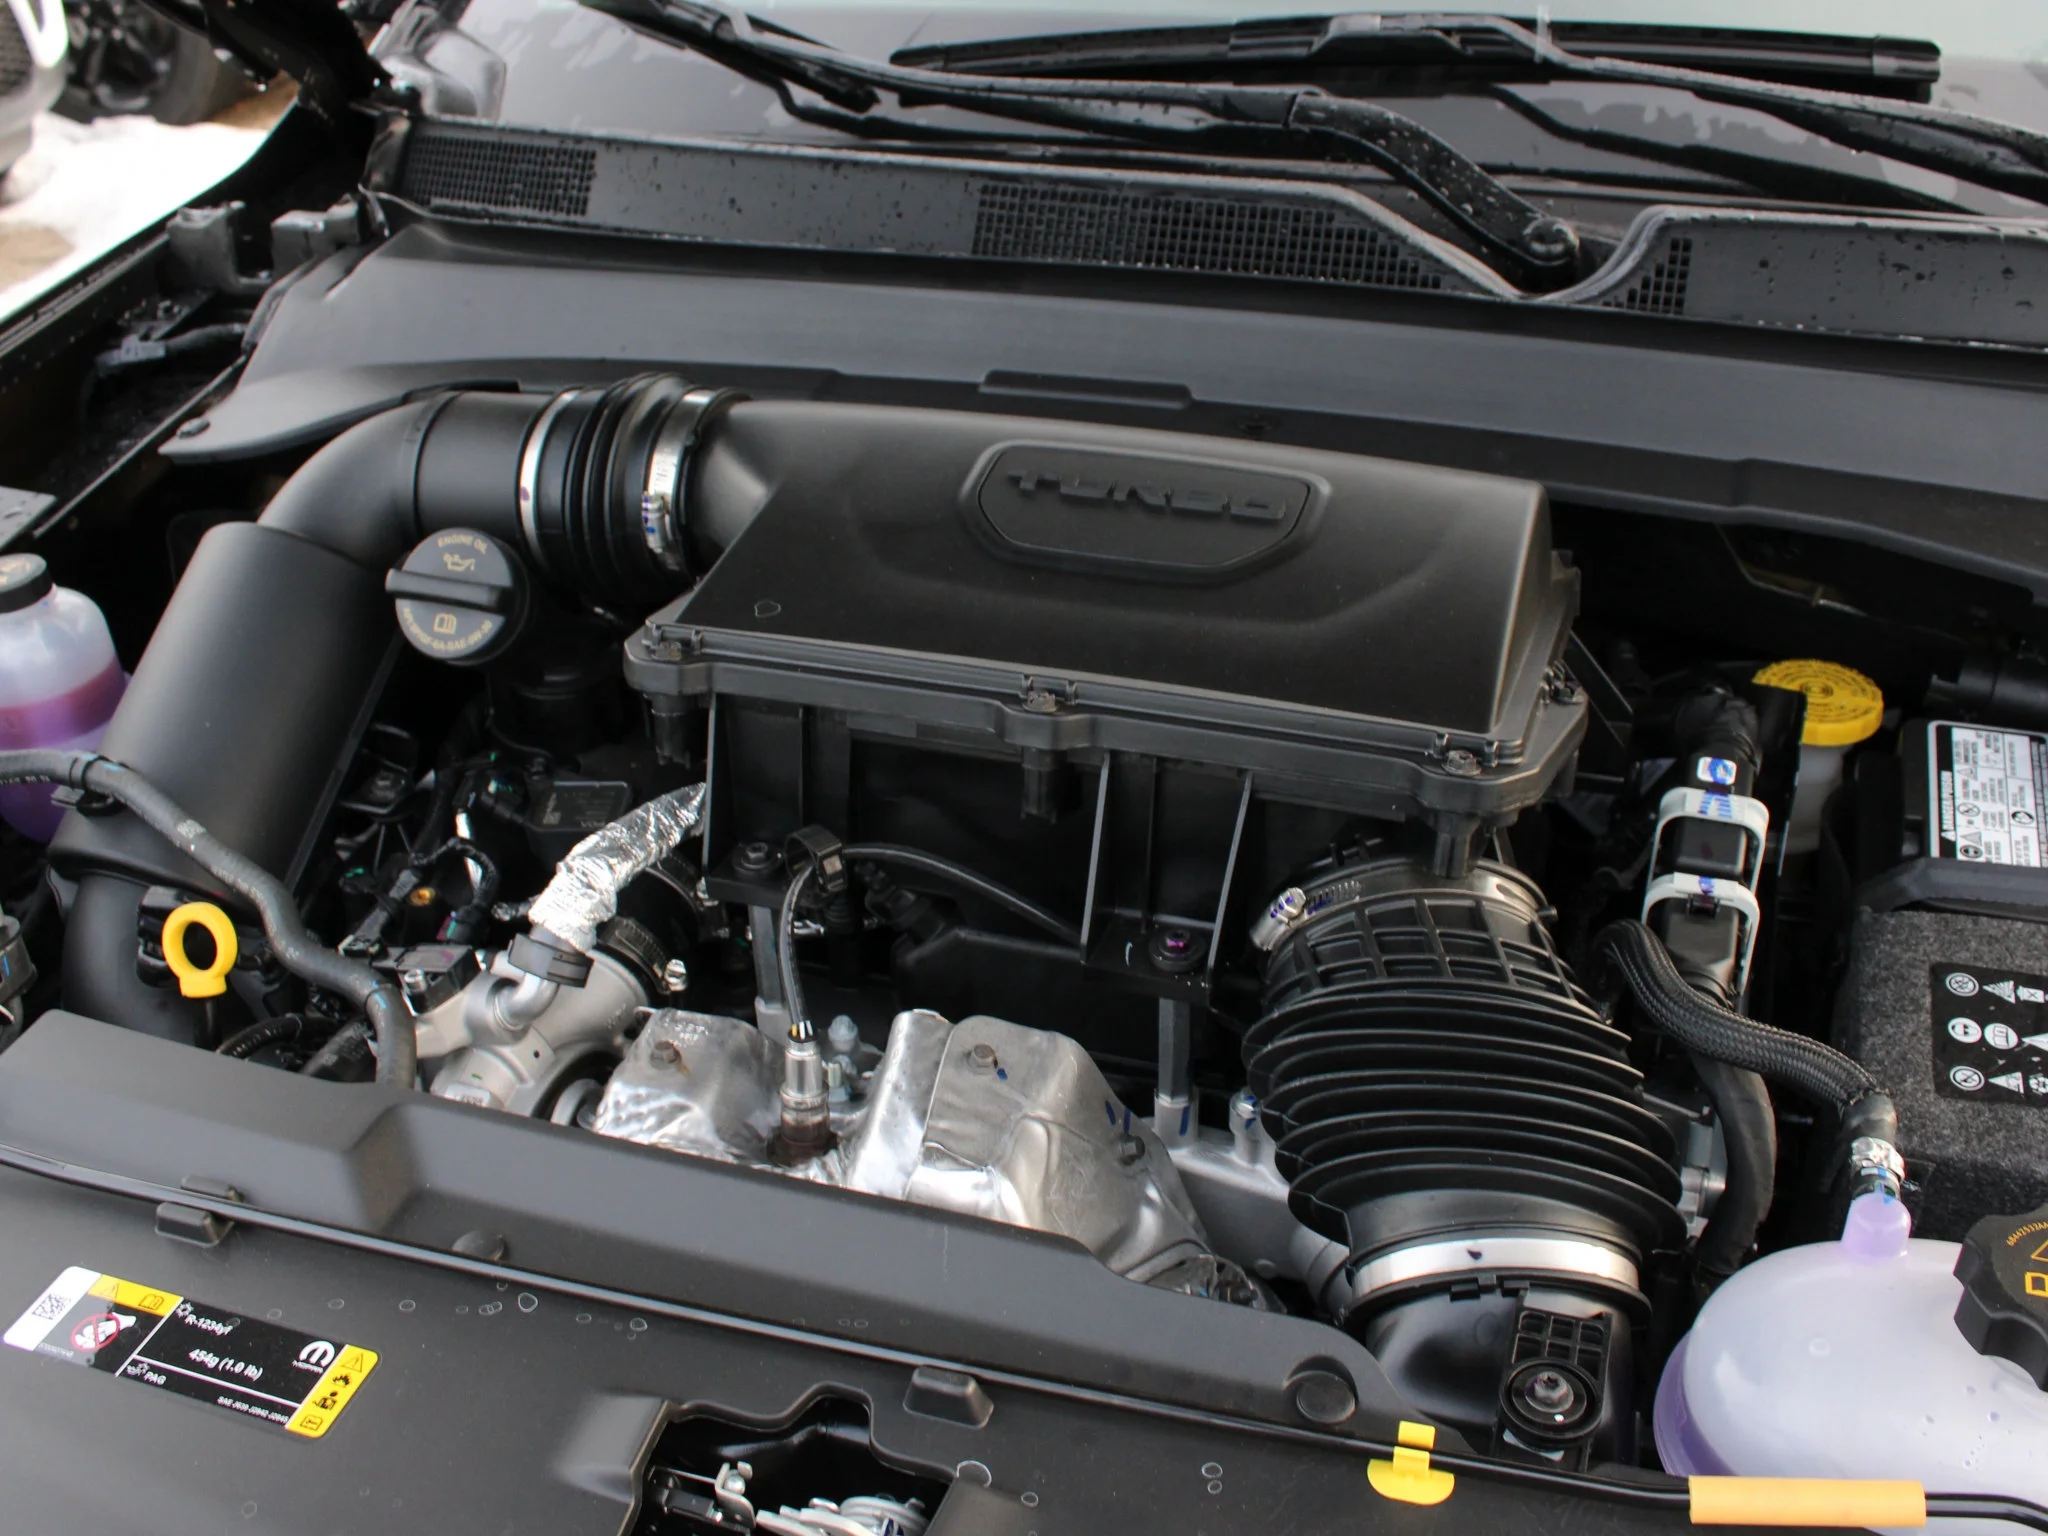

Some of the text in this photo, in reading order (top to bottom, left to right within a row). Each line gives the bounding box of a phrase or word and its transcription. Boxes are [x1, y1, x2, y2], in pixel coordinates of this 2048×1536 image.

[437, 534, 489, 555] ENGINE OIL
[188, 1348, 264, 1382] 454g (1.0 lb)
[144, 1371, 167, 1386] PAG
